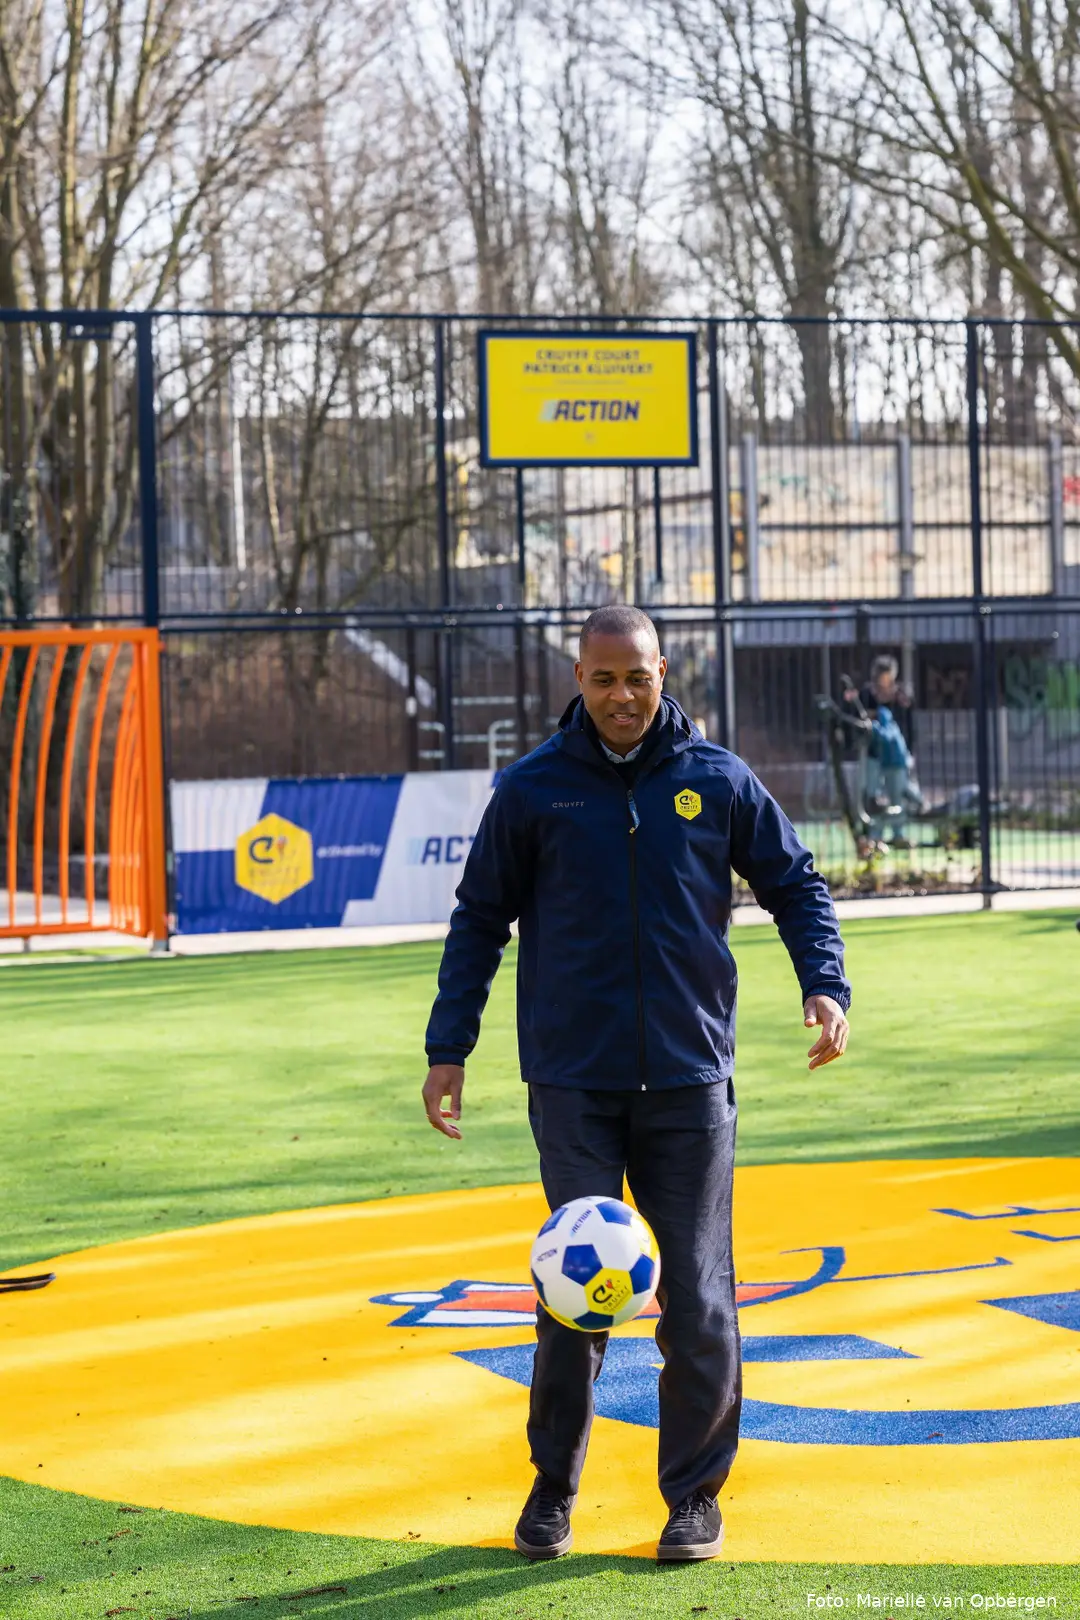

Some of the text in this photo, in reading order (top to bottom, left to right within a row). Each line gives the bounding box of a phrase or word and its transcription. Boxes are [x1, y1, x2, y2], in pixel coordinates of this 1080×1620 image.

[553, 399, 641, 422] ACTION
[552, 801, 585, 809] CRUYFF
[420, 835, 476, 866] AC
